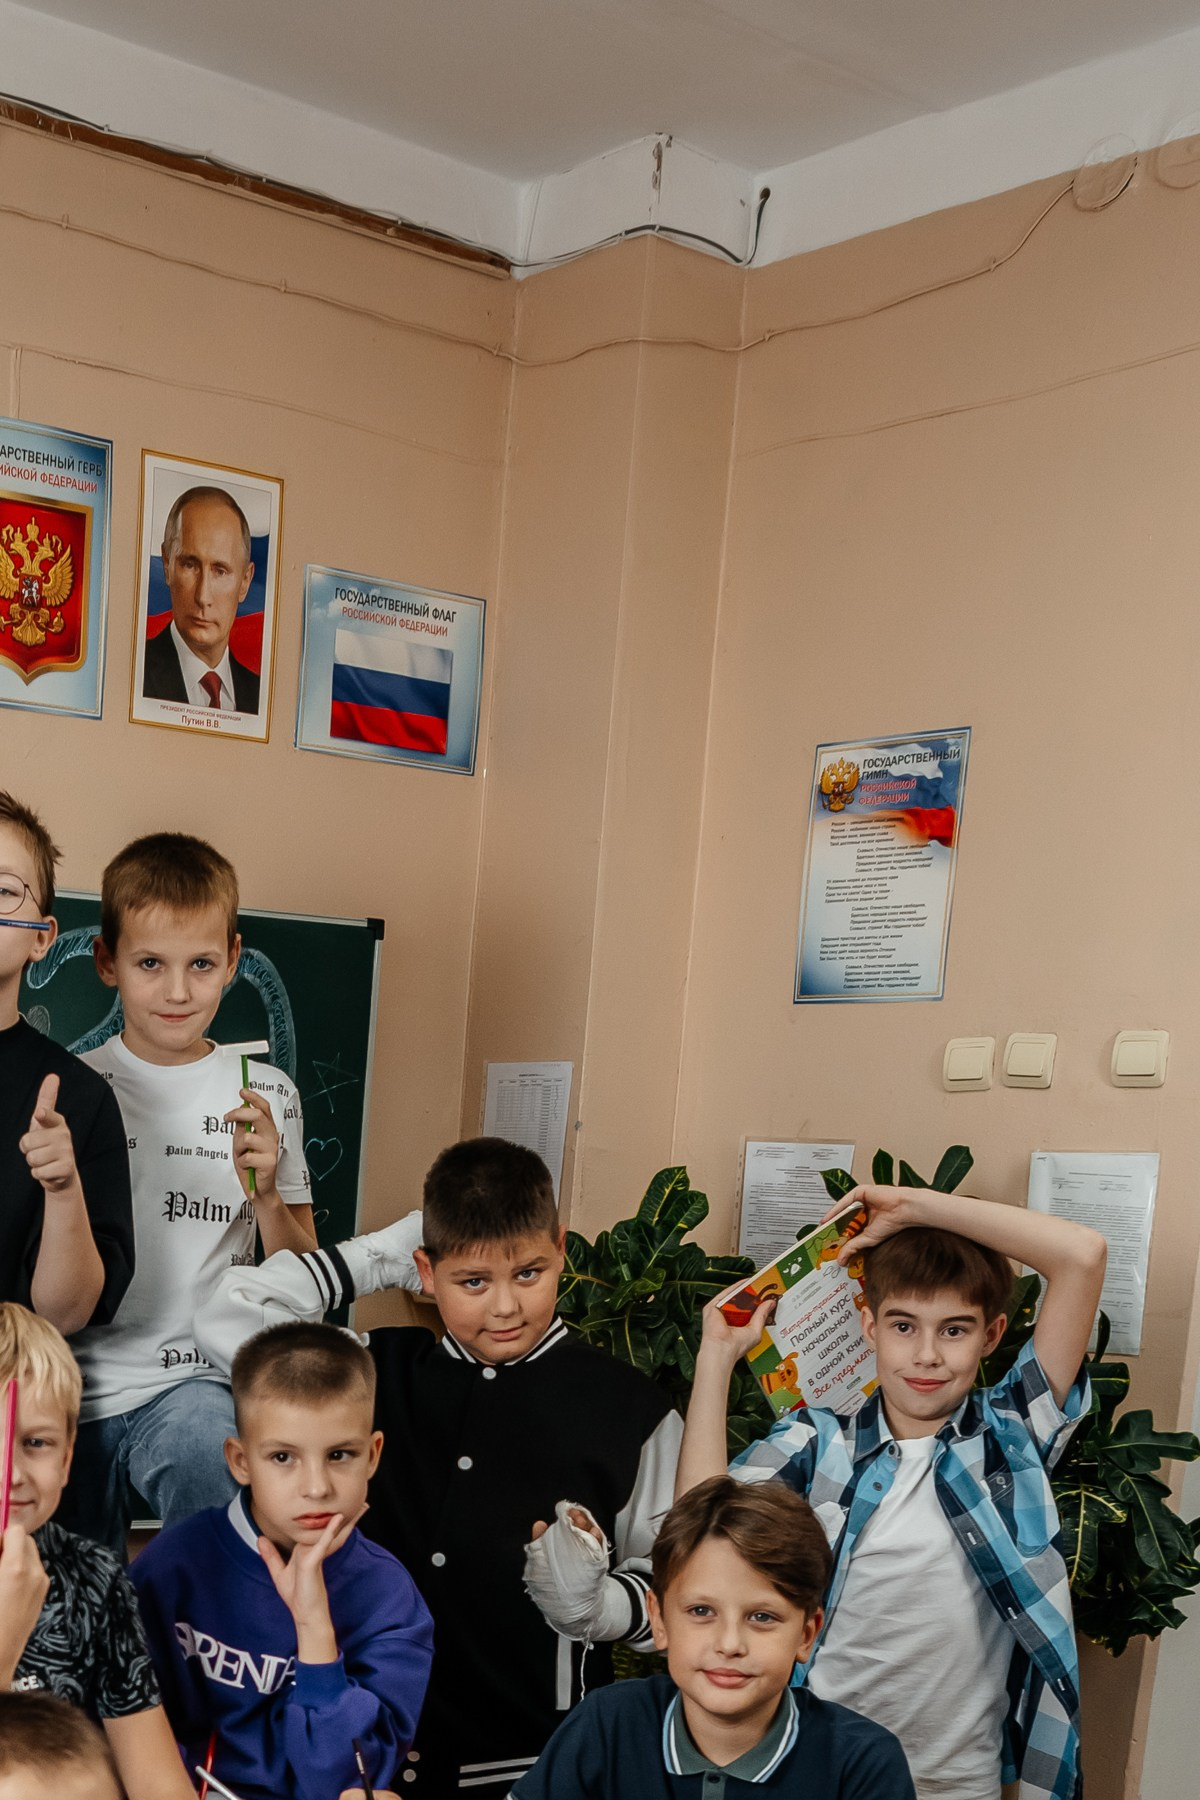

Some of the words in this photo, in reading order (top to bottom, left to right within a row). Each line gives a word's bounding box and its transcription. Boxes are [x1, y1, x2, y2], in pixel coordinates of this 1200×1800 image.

[78, 455, 103, 477] ГЕРБ
[40, 472, 98, 494] ФЕДЕРАЦИИ
[335, 587, 429, 617] ГОСУДАРСТВЕННЫЙ
[432, 607, 457, 623] ФЛАГ
[342, 607, 397, 626] РОССИЙСКОЙ
[399, 618, 448, 637] ФЕДЕРАЦИИ
[182, 715, 204, 725] Путин
[863, 747, 960, 769] ГОСУДАРСТВЕННЫЙ
[862, 769, 888, 780] ГИМН
[164, 1145, 193, 1157] Palm
[195, 1146, 230, 1160] Angels
[161, 1190, 231, 1223] Palm
[790, 1312, 829, 1347] Полный
[830, 1294, 851, 1315] курс
[801, 1310, 853, 1356] начальной
[817, 1331, 850, 1360] школы
[812, 1382, 831, 1399] Все
[831, 1349, 875, 1384] предмет
[815, 1352, 846, 1380] одной
